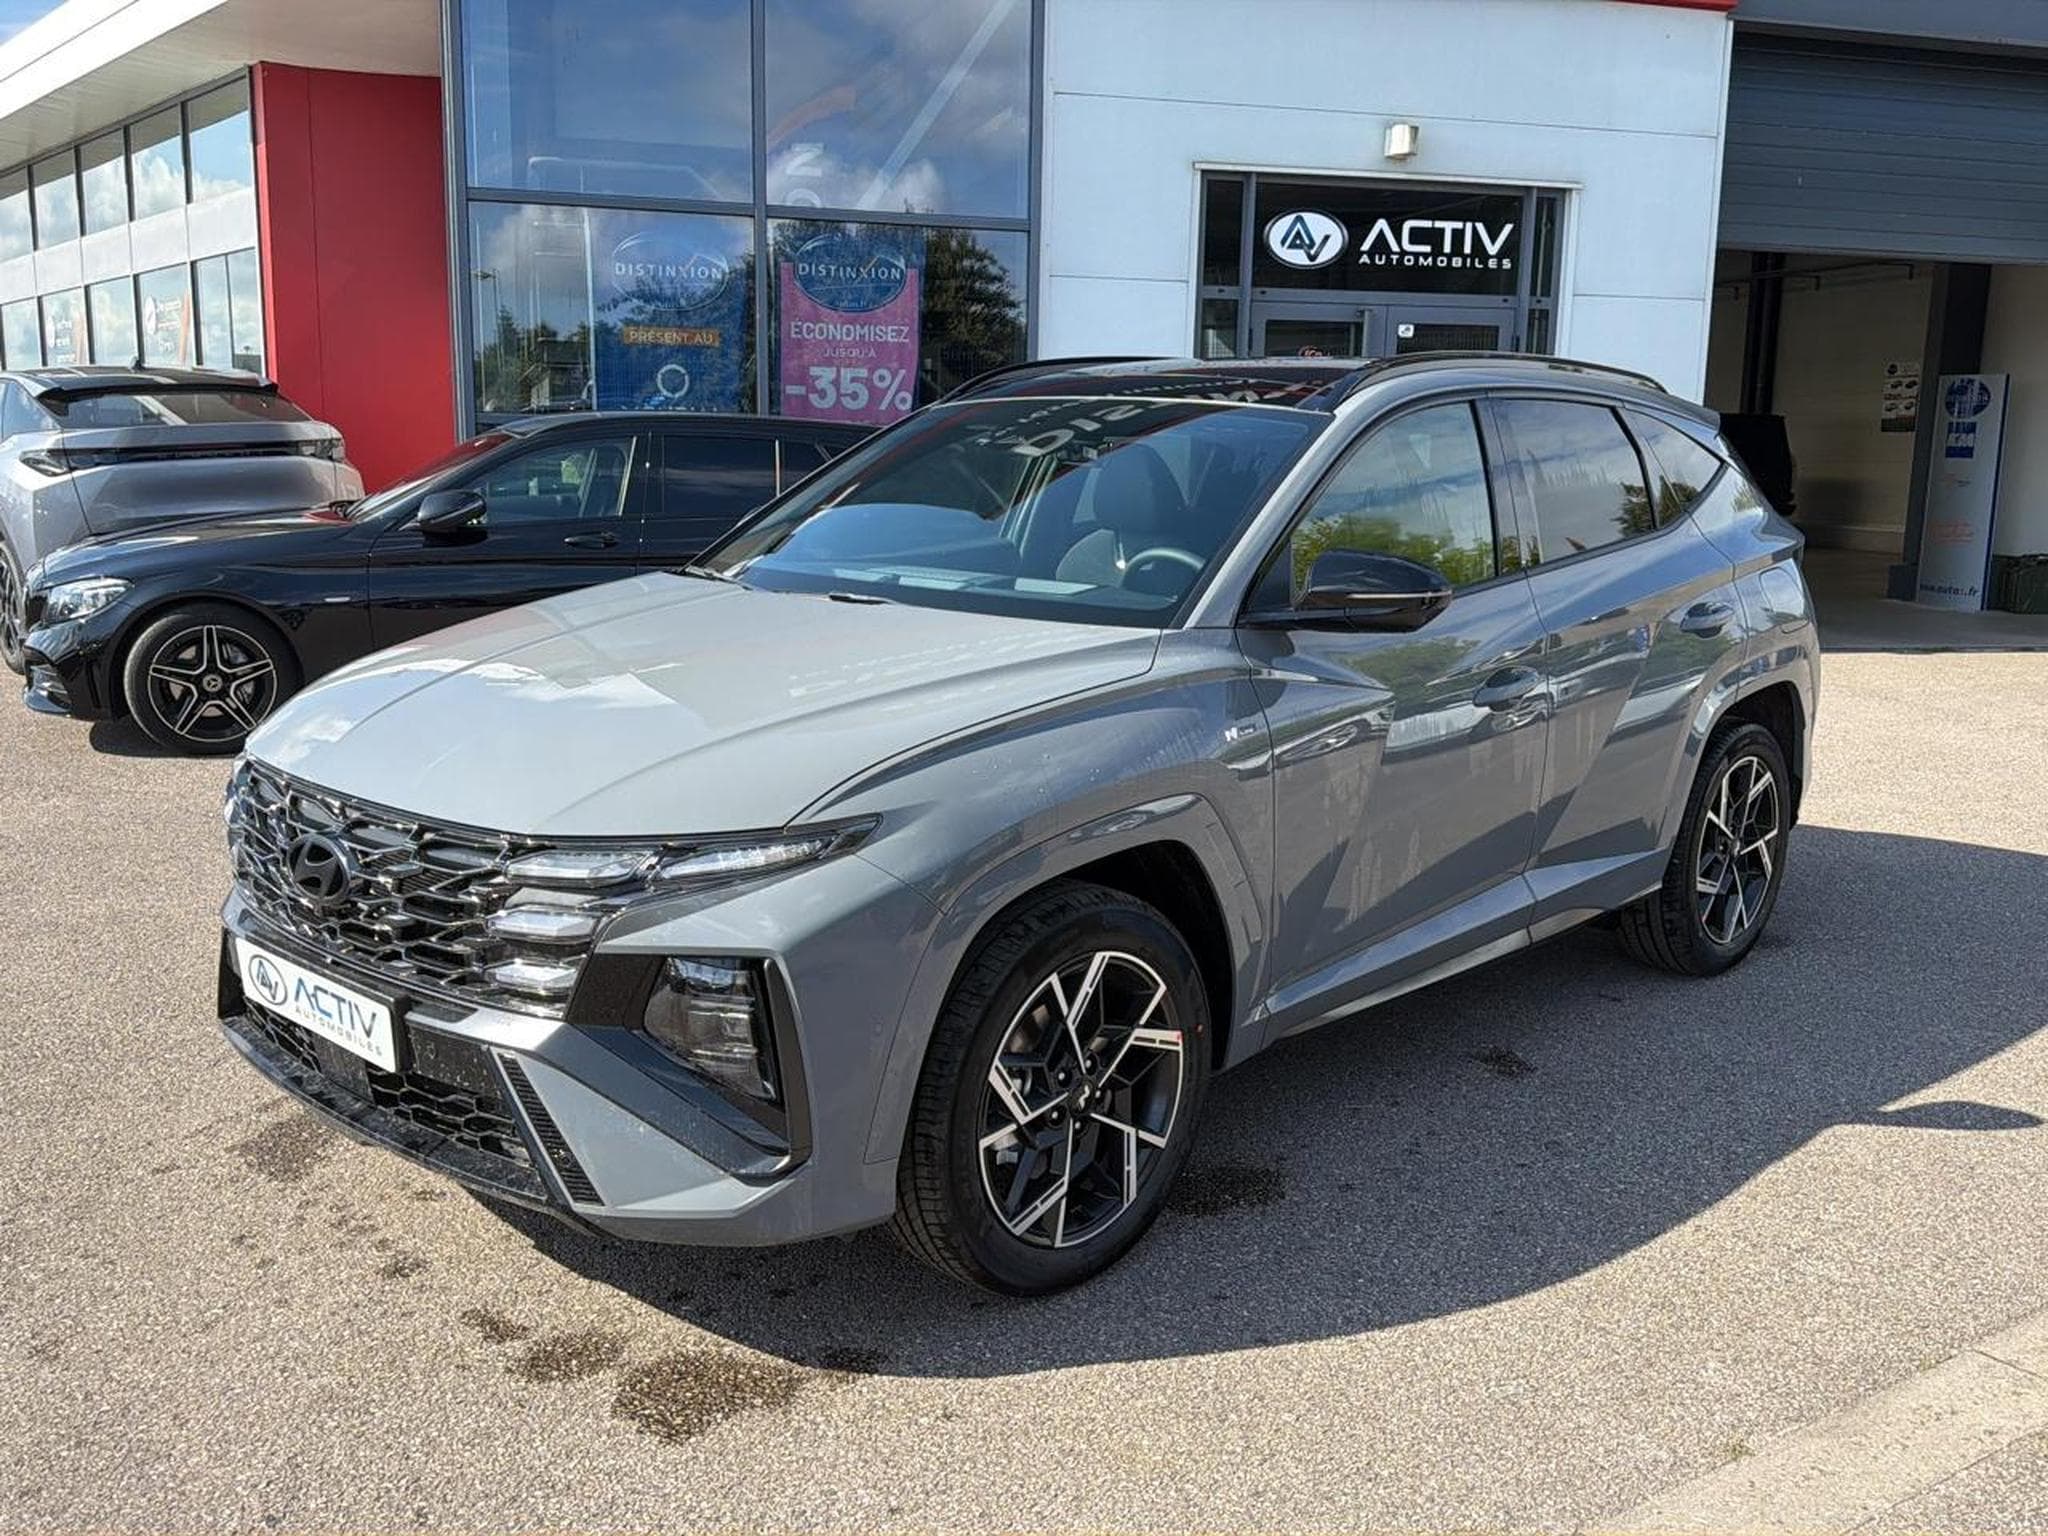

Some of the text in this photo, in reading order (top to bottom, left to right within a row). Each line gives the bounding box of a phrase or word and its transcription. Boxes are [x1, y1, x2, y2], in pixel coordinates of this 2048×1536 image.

[1360, 218, 1514, 256] ACTIV
[615, 257, 722, 280] DISTINXION
[797, 258, 902, 280] DISTINXION
[1358, 253, 1512, 270] AUTOMOBILES
[629, 329, 714, 344] PRÉSENT AU
[790, 317, 910, 342] ÉCONOMISEZ
[784, 365, 914, 412] -35%
[294, 977, 377, 1039] ACTIV
[295, 1006, 382, 1057] AUTOMOBILES
